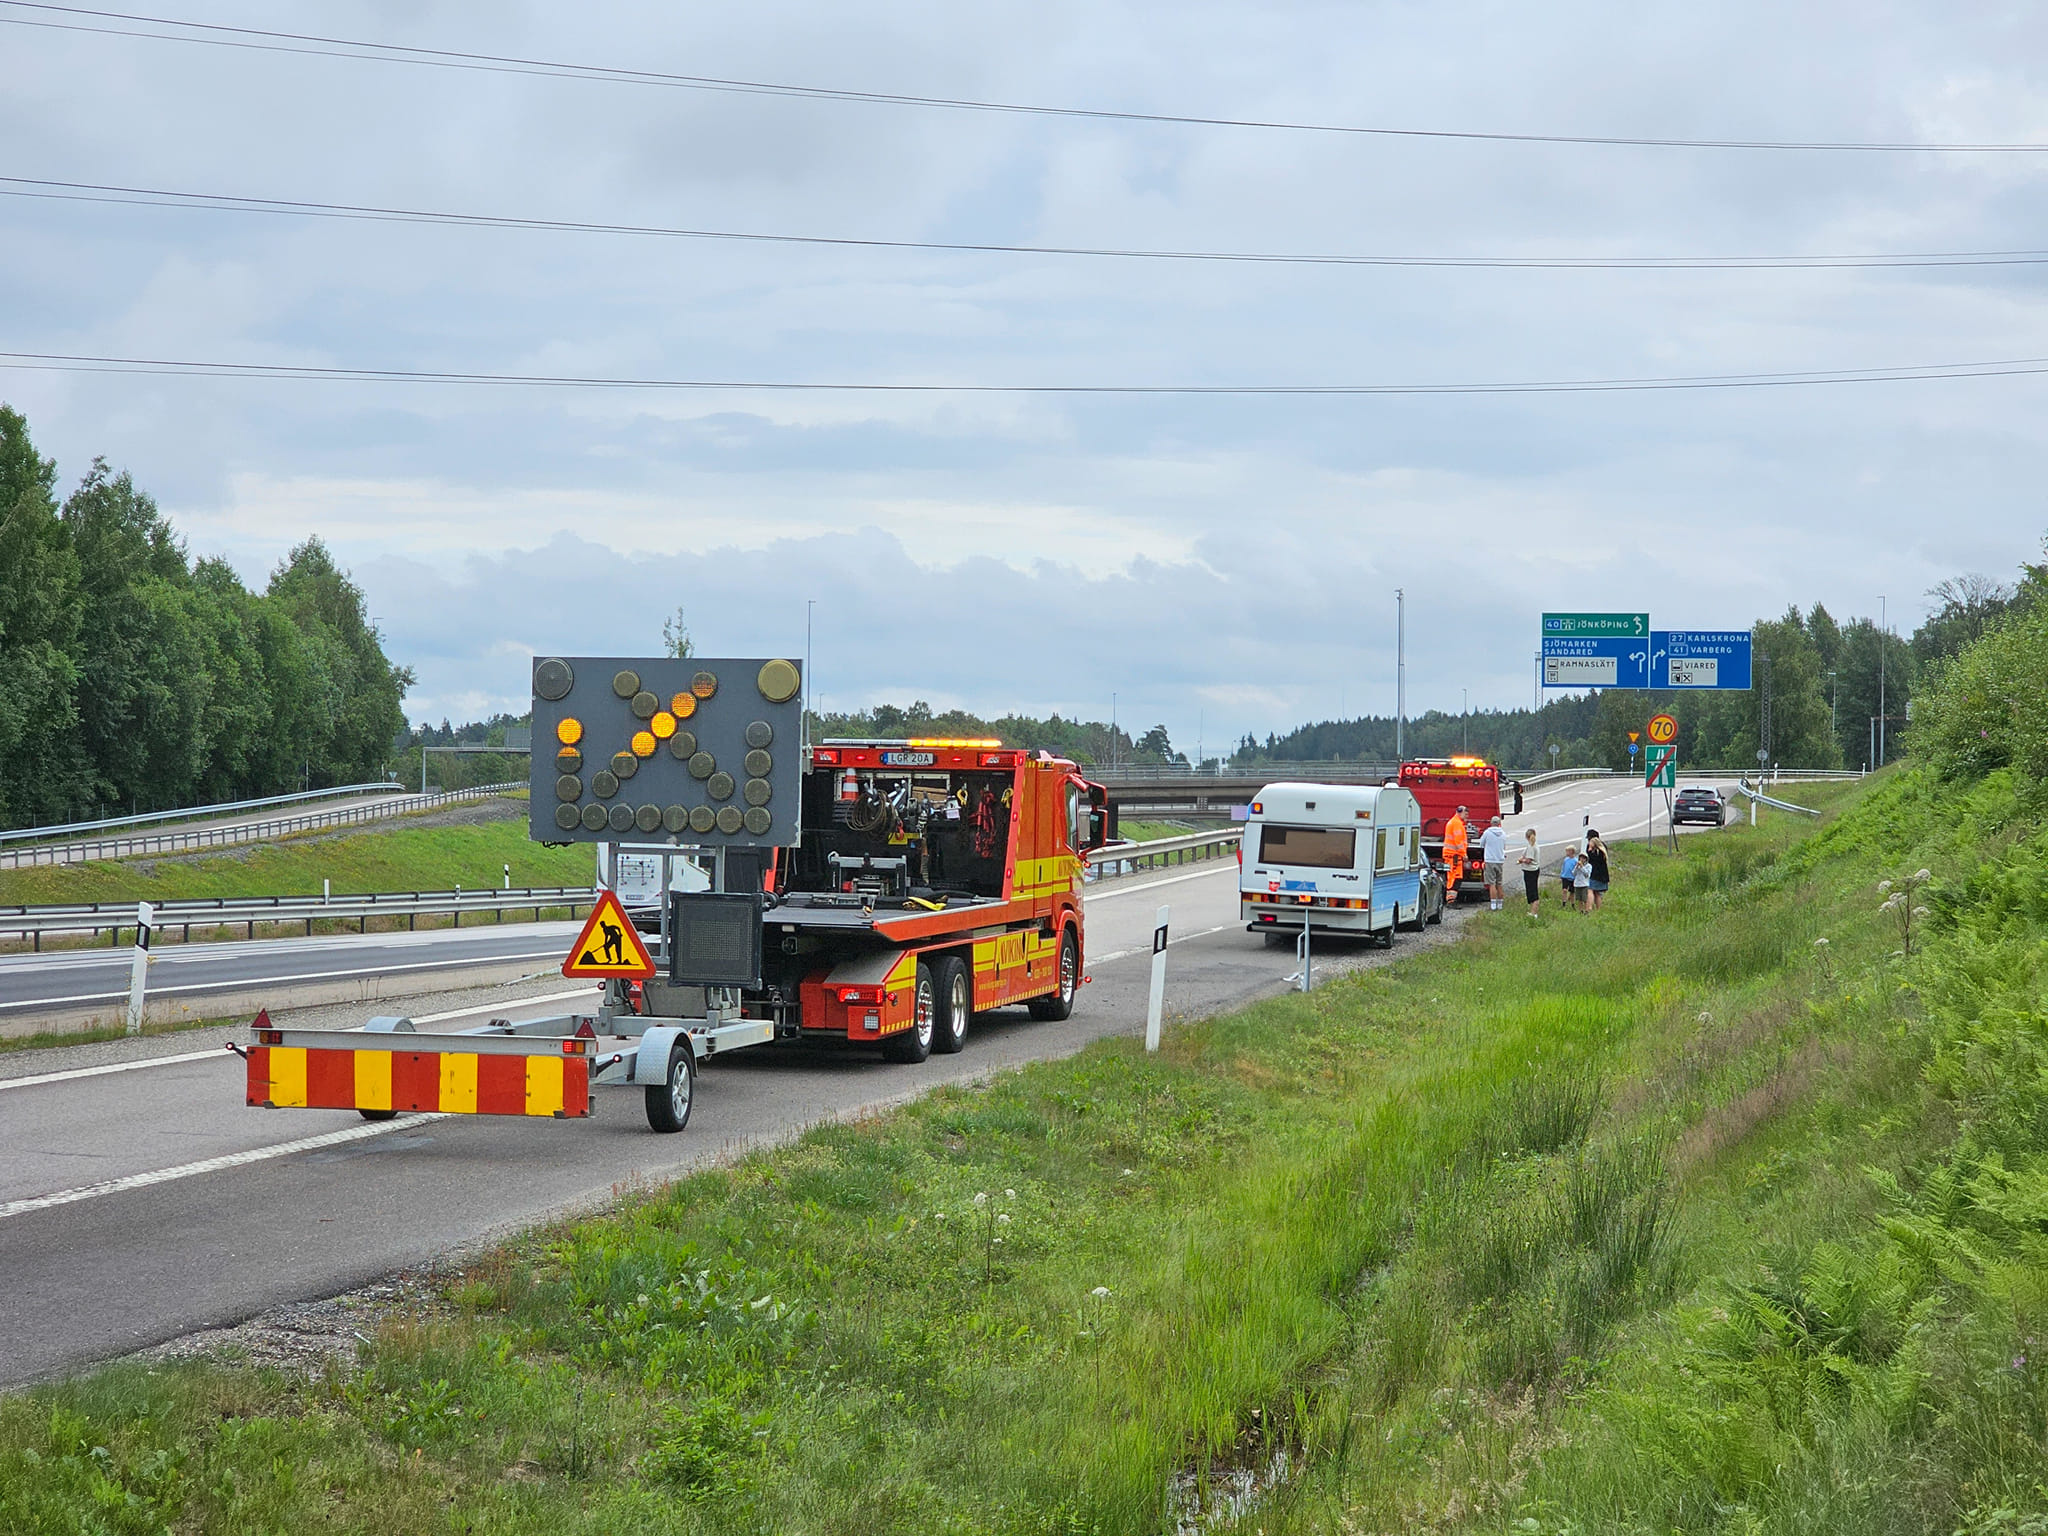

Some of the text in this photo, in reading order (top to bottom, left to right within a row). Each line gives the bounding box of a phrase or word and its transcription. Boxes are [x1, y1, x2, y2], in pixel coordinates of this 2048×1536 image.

[1546, 619, 1629, 629] 40 JÖNKÖPING
[1687, 634, 1749, 642] KARLSKRONA
[1544, 639, 1598, 648] SJÖMARKEN
[1544, 648, 1593, 656] SANDARED
[1690, 646, 1733, 654] VARBERG
[1560, 659, 1616, 668] RAMNASLÄTT
[1684, 662, 1716, 670] VIARED
[1654, 721, 1673, 737] 70
[891, 753, 930, 763] LGR 20A
[1000, 936, 1025, 965] VIKIN
